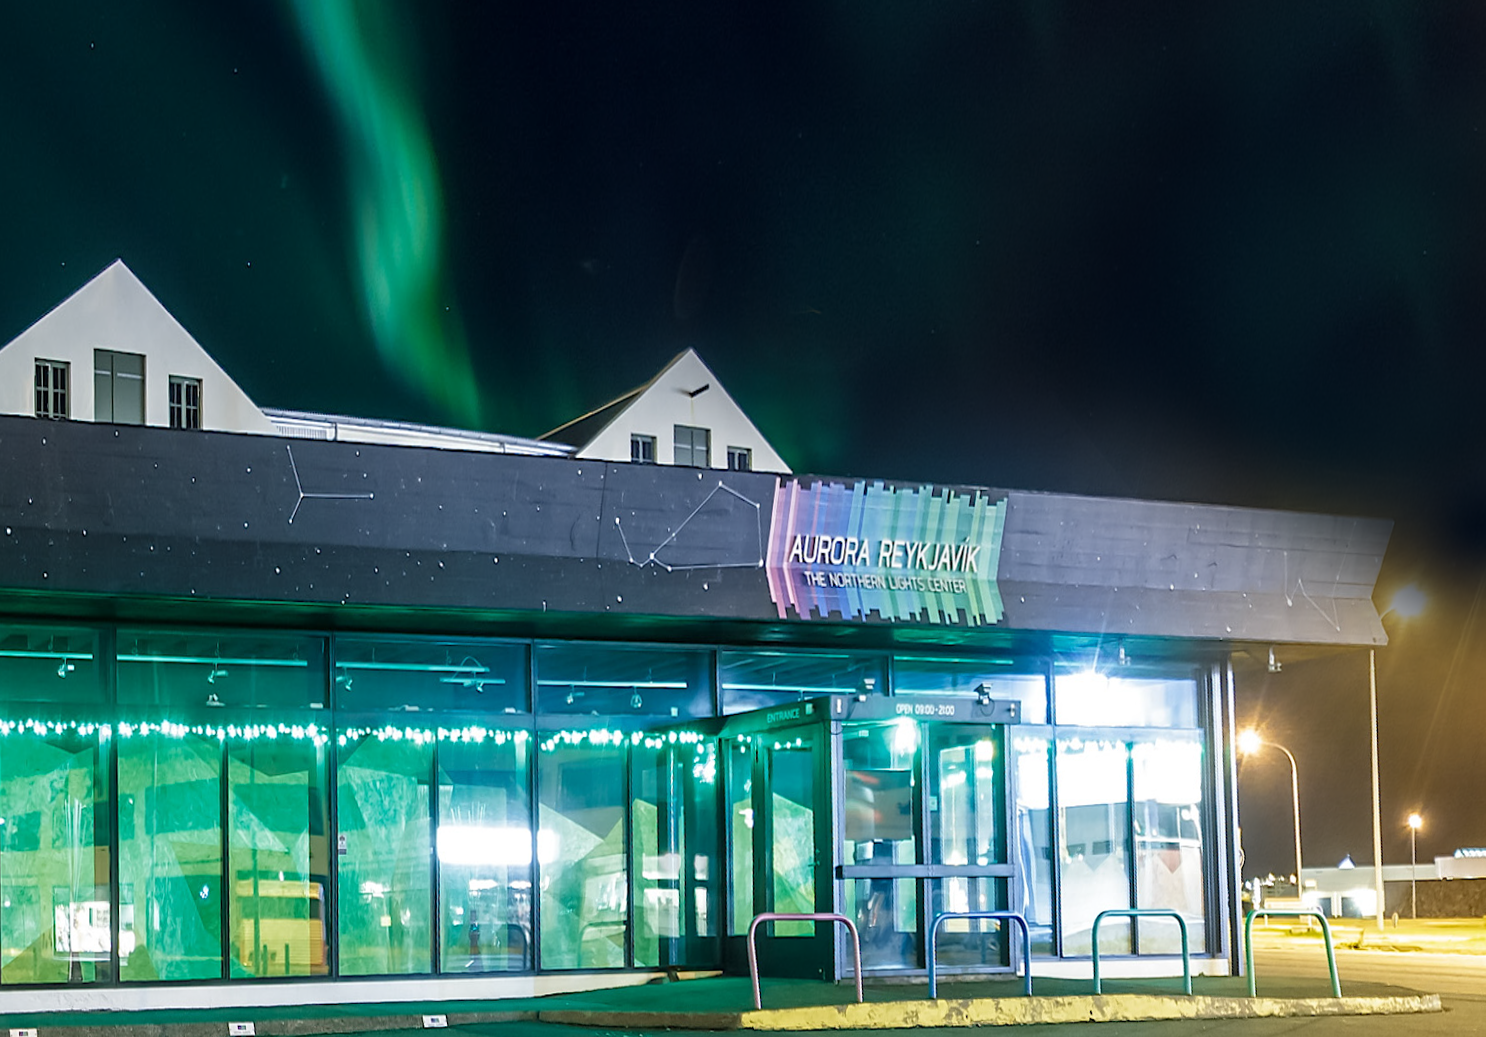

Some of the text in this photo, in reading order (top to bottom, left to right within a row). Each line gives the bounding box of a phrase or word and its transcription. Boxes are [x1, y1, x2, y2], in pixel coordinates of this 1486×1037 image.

[789, 534, 981, 573] AURORA REYKJAVÍK
[804, 571, 967, 593] THE NORTHERN LIGHTS CENTER
[767, 708, 800, 723] ENTRANCE
[896, 703, 913, 714] OPEN
